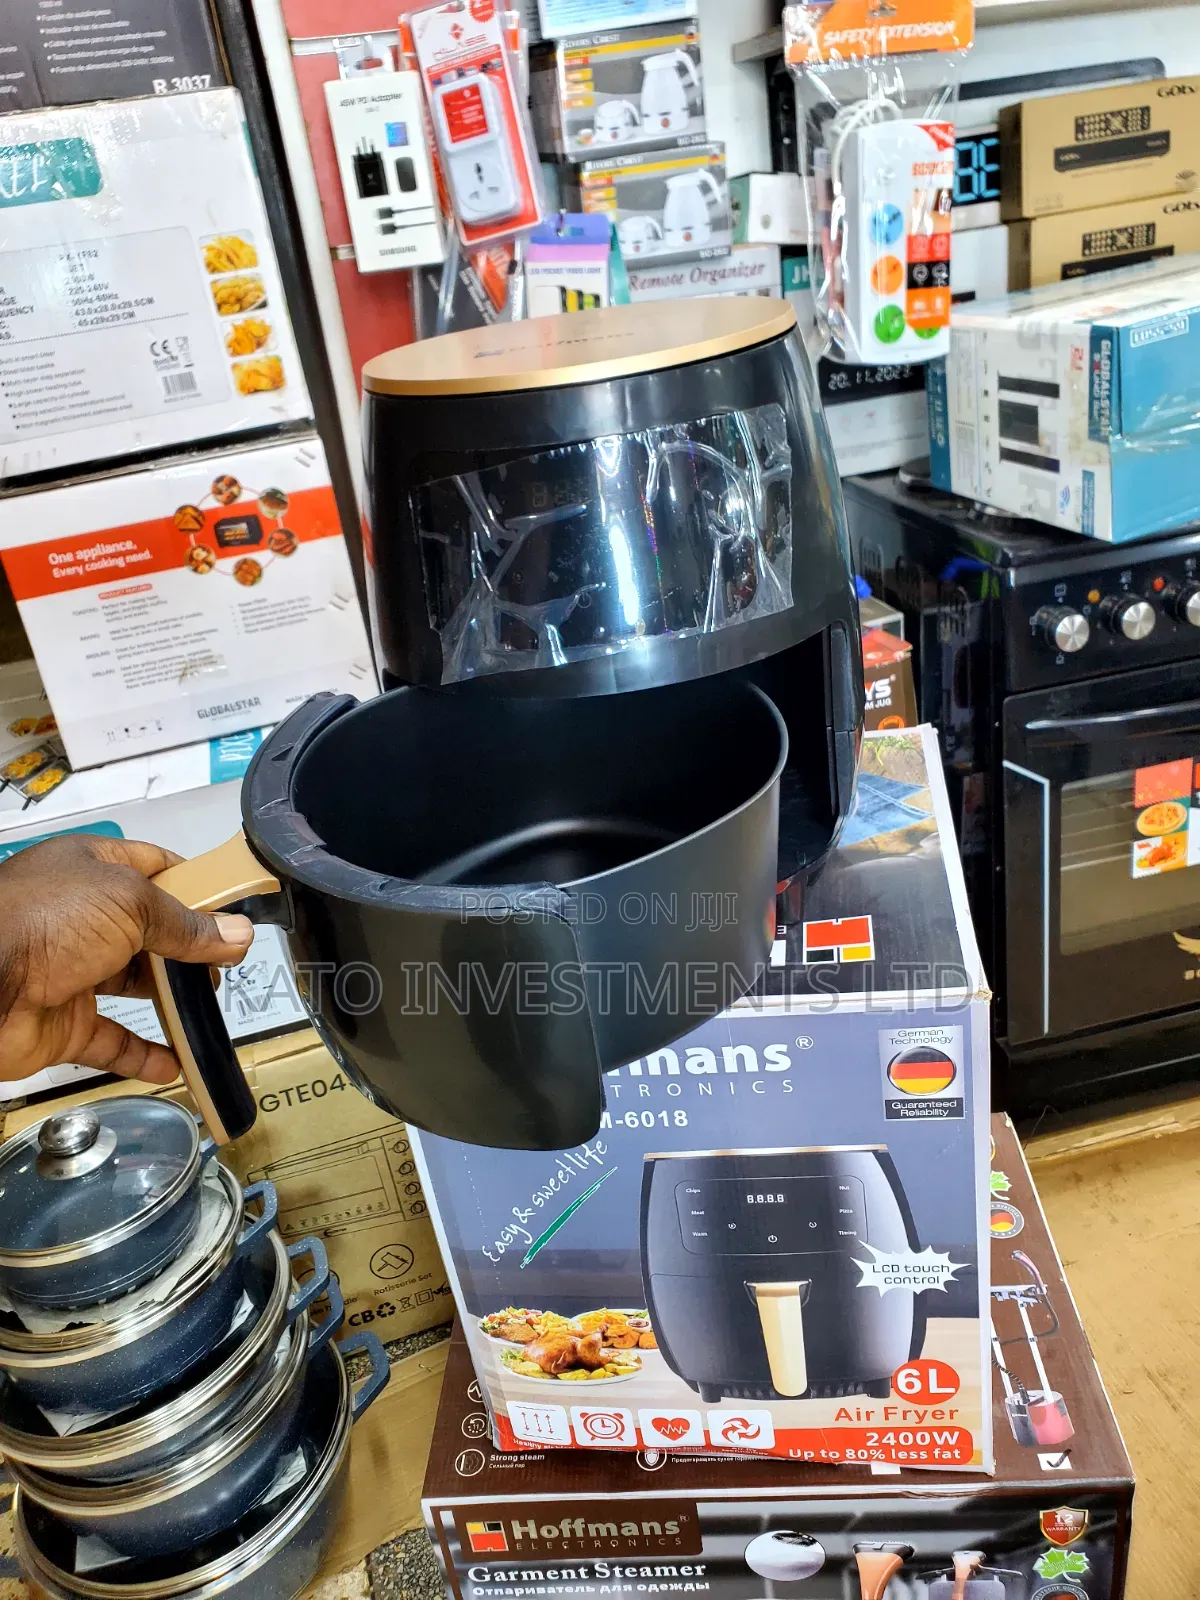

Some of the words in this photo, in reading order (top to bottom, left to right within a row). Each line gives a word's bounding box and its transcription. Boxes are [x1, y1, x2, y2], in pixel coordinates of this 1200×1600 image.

[152, 78, 168, 95] R
[171, 74, 212, 93] 3037
[629, 270, 684, 292] Remote
[689, 261, 767, 286] Organizer
[48, 551, 74, 566] One
[52, 563, 84, 580] Every
[84, 556, 126, 574] cooking
[197, 696, 263, 720] GLOBALSTAR
[874, 697, 893, 709] JUG
[888, 1035, 955, 1047] Technology
[897, 1028, 945, 1039] German
[891, 1099, 958, 1112] Guaranteed
[899, 1106, 951, 1118] Reliability
[481, 1222, 533, 1263] Easy
[511, 1205, 536, 1224] &
[871, 1263, 901, 1275] LCD
[903, 1263, 951, 1274] touch
[373, 1277, 417, 1297] Rotisserie
[883, 1274, 941, 1286] control
[896, 1367, 957, 1396] 6L
[834, 1406, 875, 1423] Air
[883, 1405, 960, 1425] Fryer
[865, 1431, 961, 1448] 2400W
[489, 1454, 519, 1465] Strong
[519, 1453, 546, 1462] steam
[788, 1448, 816, 1462] Up
[818, 1449, 841, 1460] to
[845, 1448, 886, 1461] 80%
[891, 1448, 929, 1460] less
[932, 1448, 962, 1460] fat
[1054, 1513, 1074, 1524] 12
[511, 1517, 681, 1541] Hoffmans
[515, 1536, 683, 1551] ELECTRONICS
[466, 1565, 591, 1584] Garment
[593, 1561, 708, 1581] Steamer
[472, 1584, 597, 1598] Отпариватель
[599, 1583, 634, 1595] для
[636, 1581, 711, 1594] одежды
